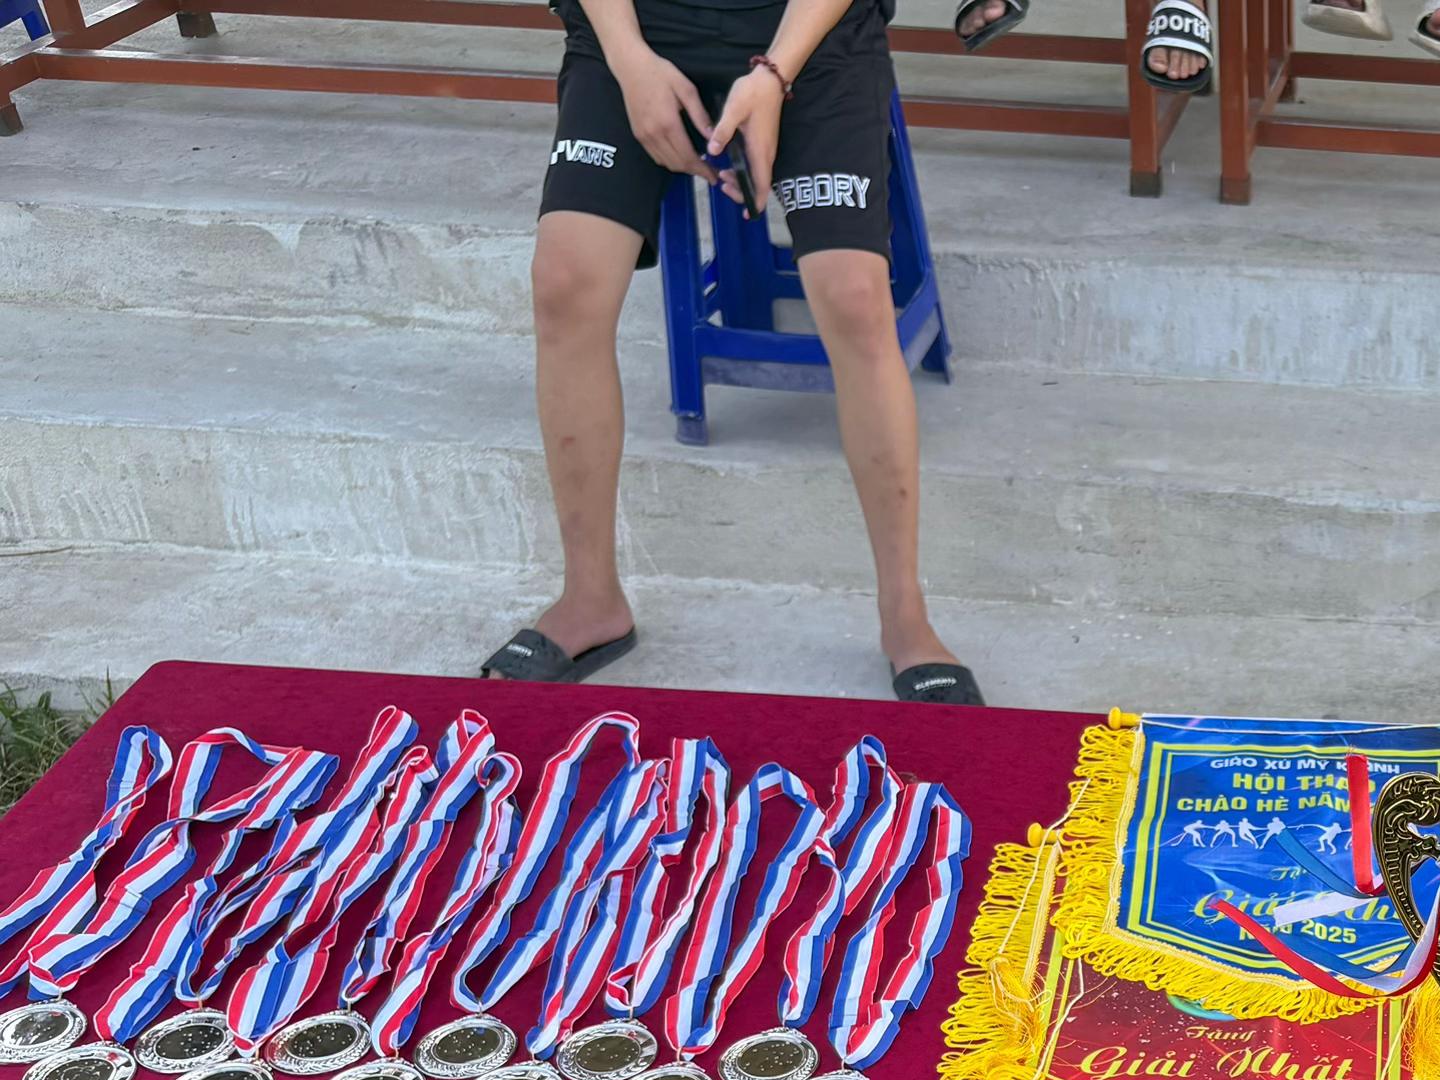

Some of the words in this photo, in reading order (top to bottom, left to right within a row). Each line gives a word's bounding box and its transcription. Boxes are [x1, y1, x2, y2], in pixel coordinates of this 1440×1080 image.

[773, 174, 870, 214] EGORY
[1232, 772, 1285, 795] HỘI
[1176, 794, 1248, 813] CHÀO
[1256, 795, 1289, 813] HÈ
[1300, 918, 1357, 944] 2025
[1079, 1046, 1199, 1080] Giải
